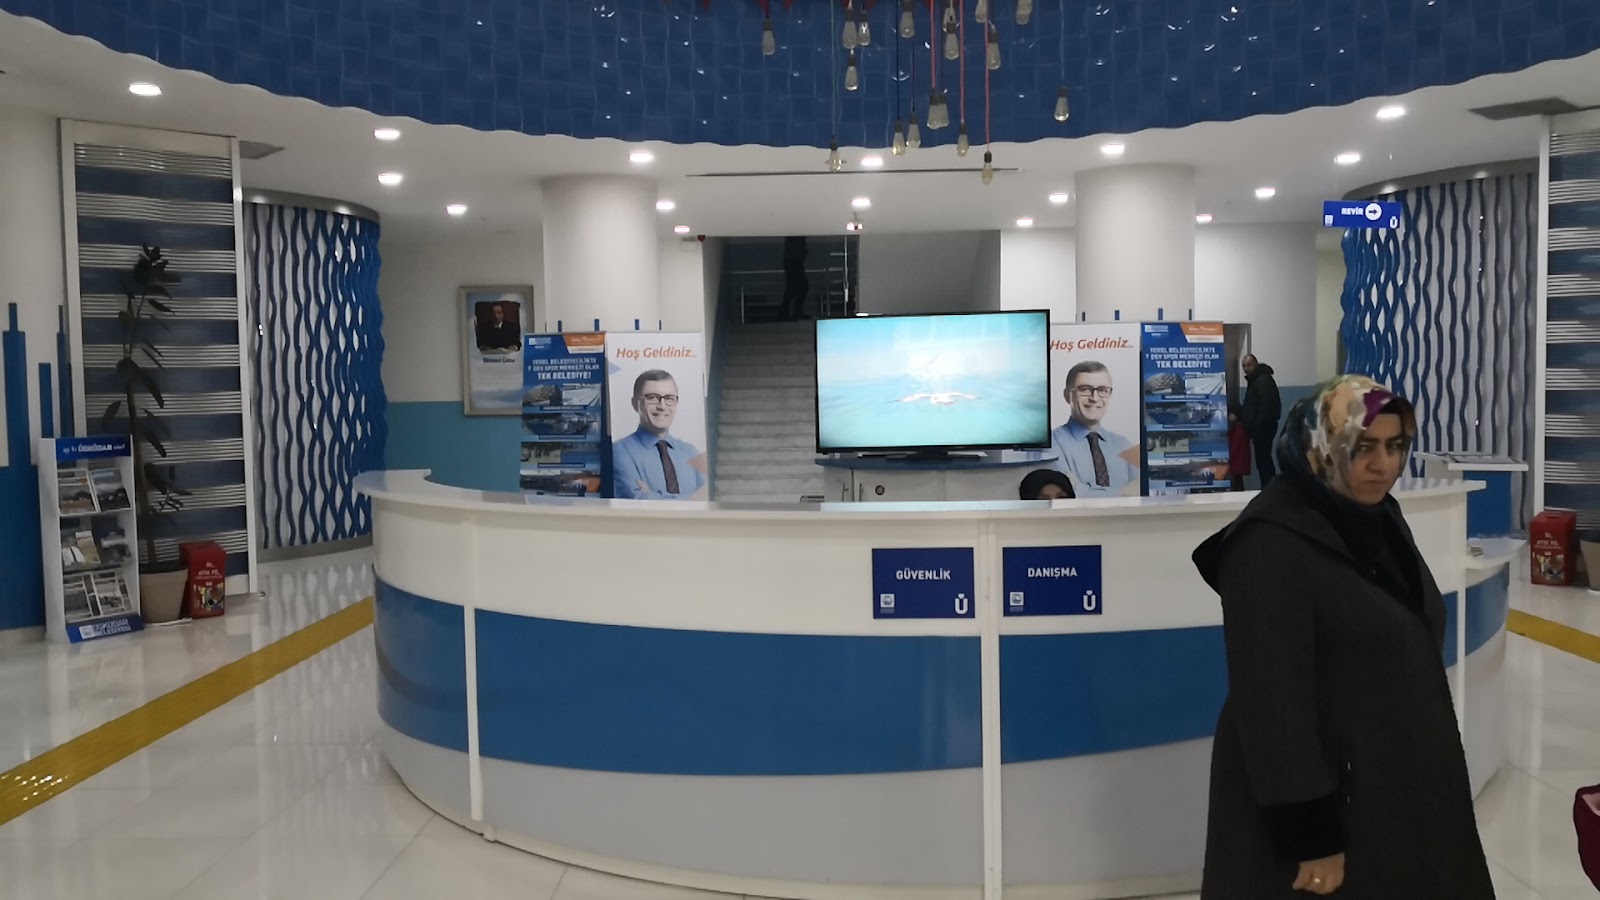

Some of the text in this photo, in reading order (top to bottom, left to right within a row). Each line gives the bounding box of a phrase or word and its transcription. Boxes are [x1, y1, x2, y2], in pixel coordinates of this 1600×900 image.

[1341, 206, 1364, 216] REVİR
[1050, 339, 1074, 353] Hoş
[616, 347, 640, 361] Hoş
[1156, 359, 1211, 369] TEK BELEDİYE!
[537, 371, 591, 380] TEK BELEDİYE!
[895, 567, 951, 580] GÜVENLİK
[1027, 566, 1078, 579] DANIŞMA
